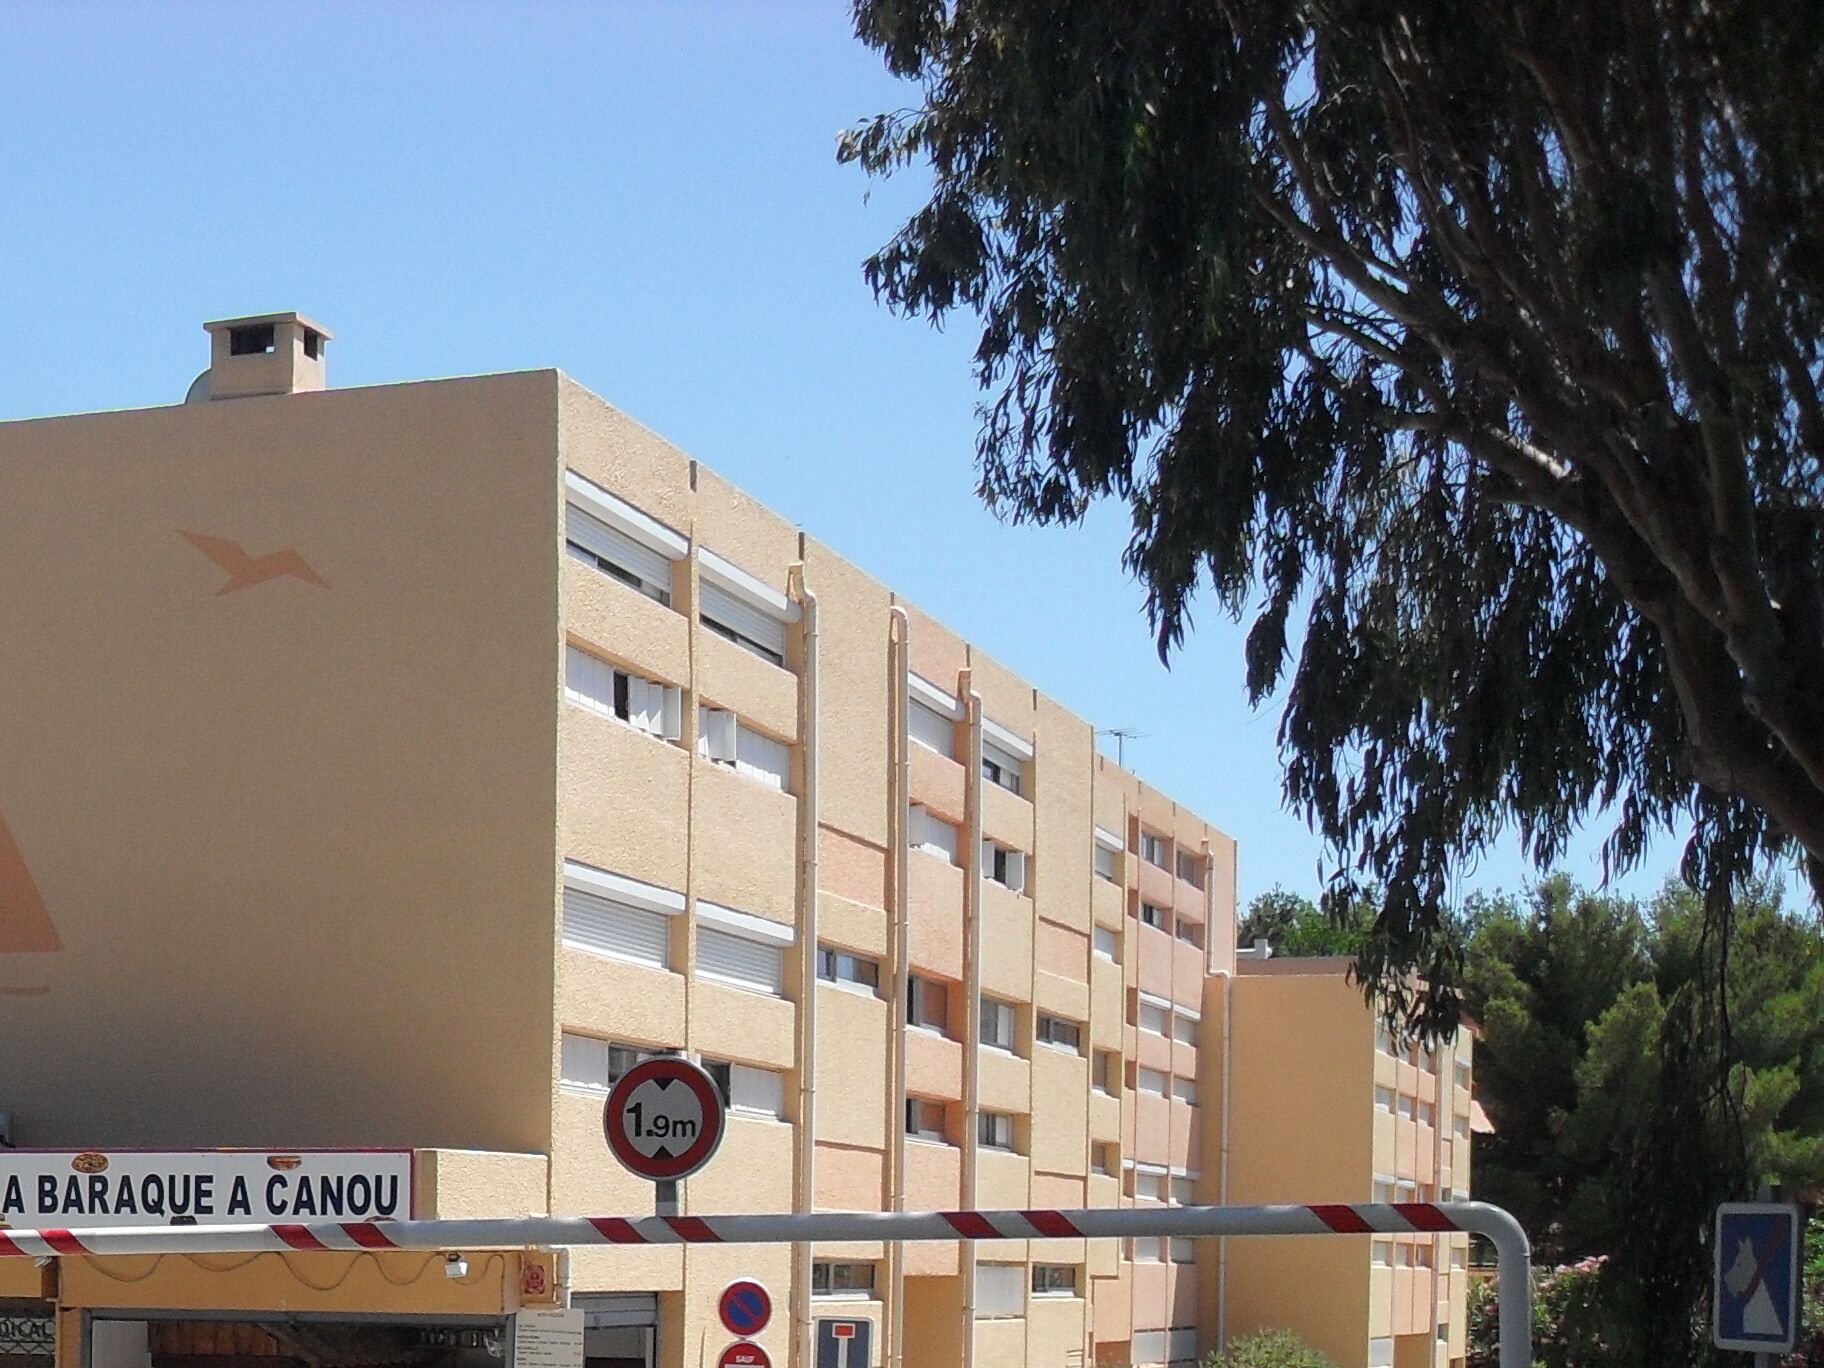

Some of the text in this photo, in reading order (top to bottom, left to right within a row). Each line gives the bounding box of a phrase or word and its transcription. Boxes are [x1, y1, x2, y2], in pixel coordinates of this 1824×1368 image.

[626, 1102, 695, 1138] 1.9m
[37, 1173, 215, 1218] BARAQUE
[226, 1175, 253, 1216] A
[265, 1174, 399, 1217] CANOU
